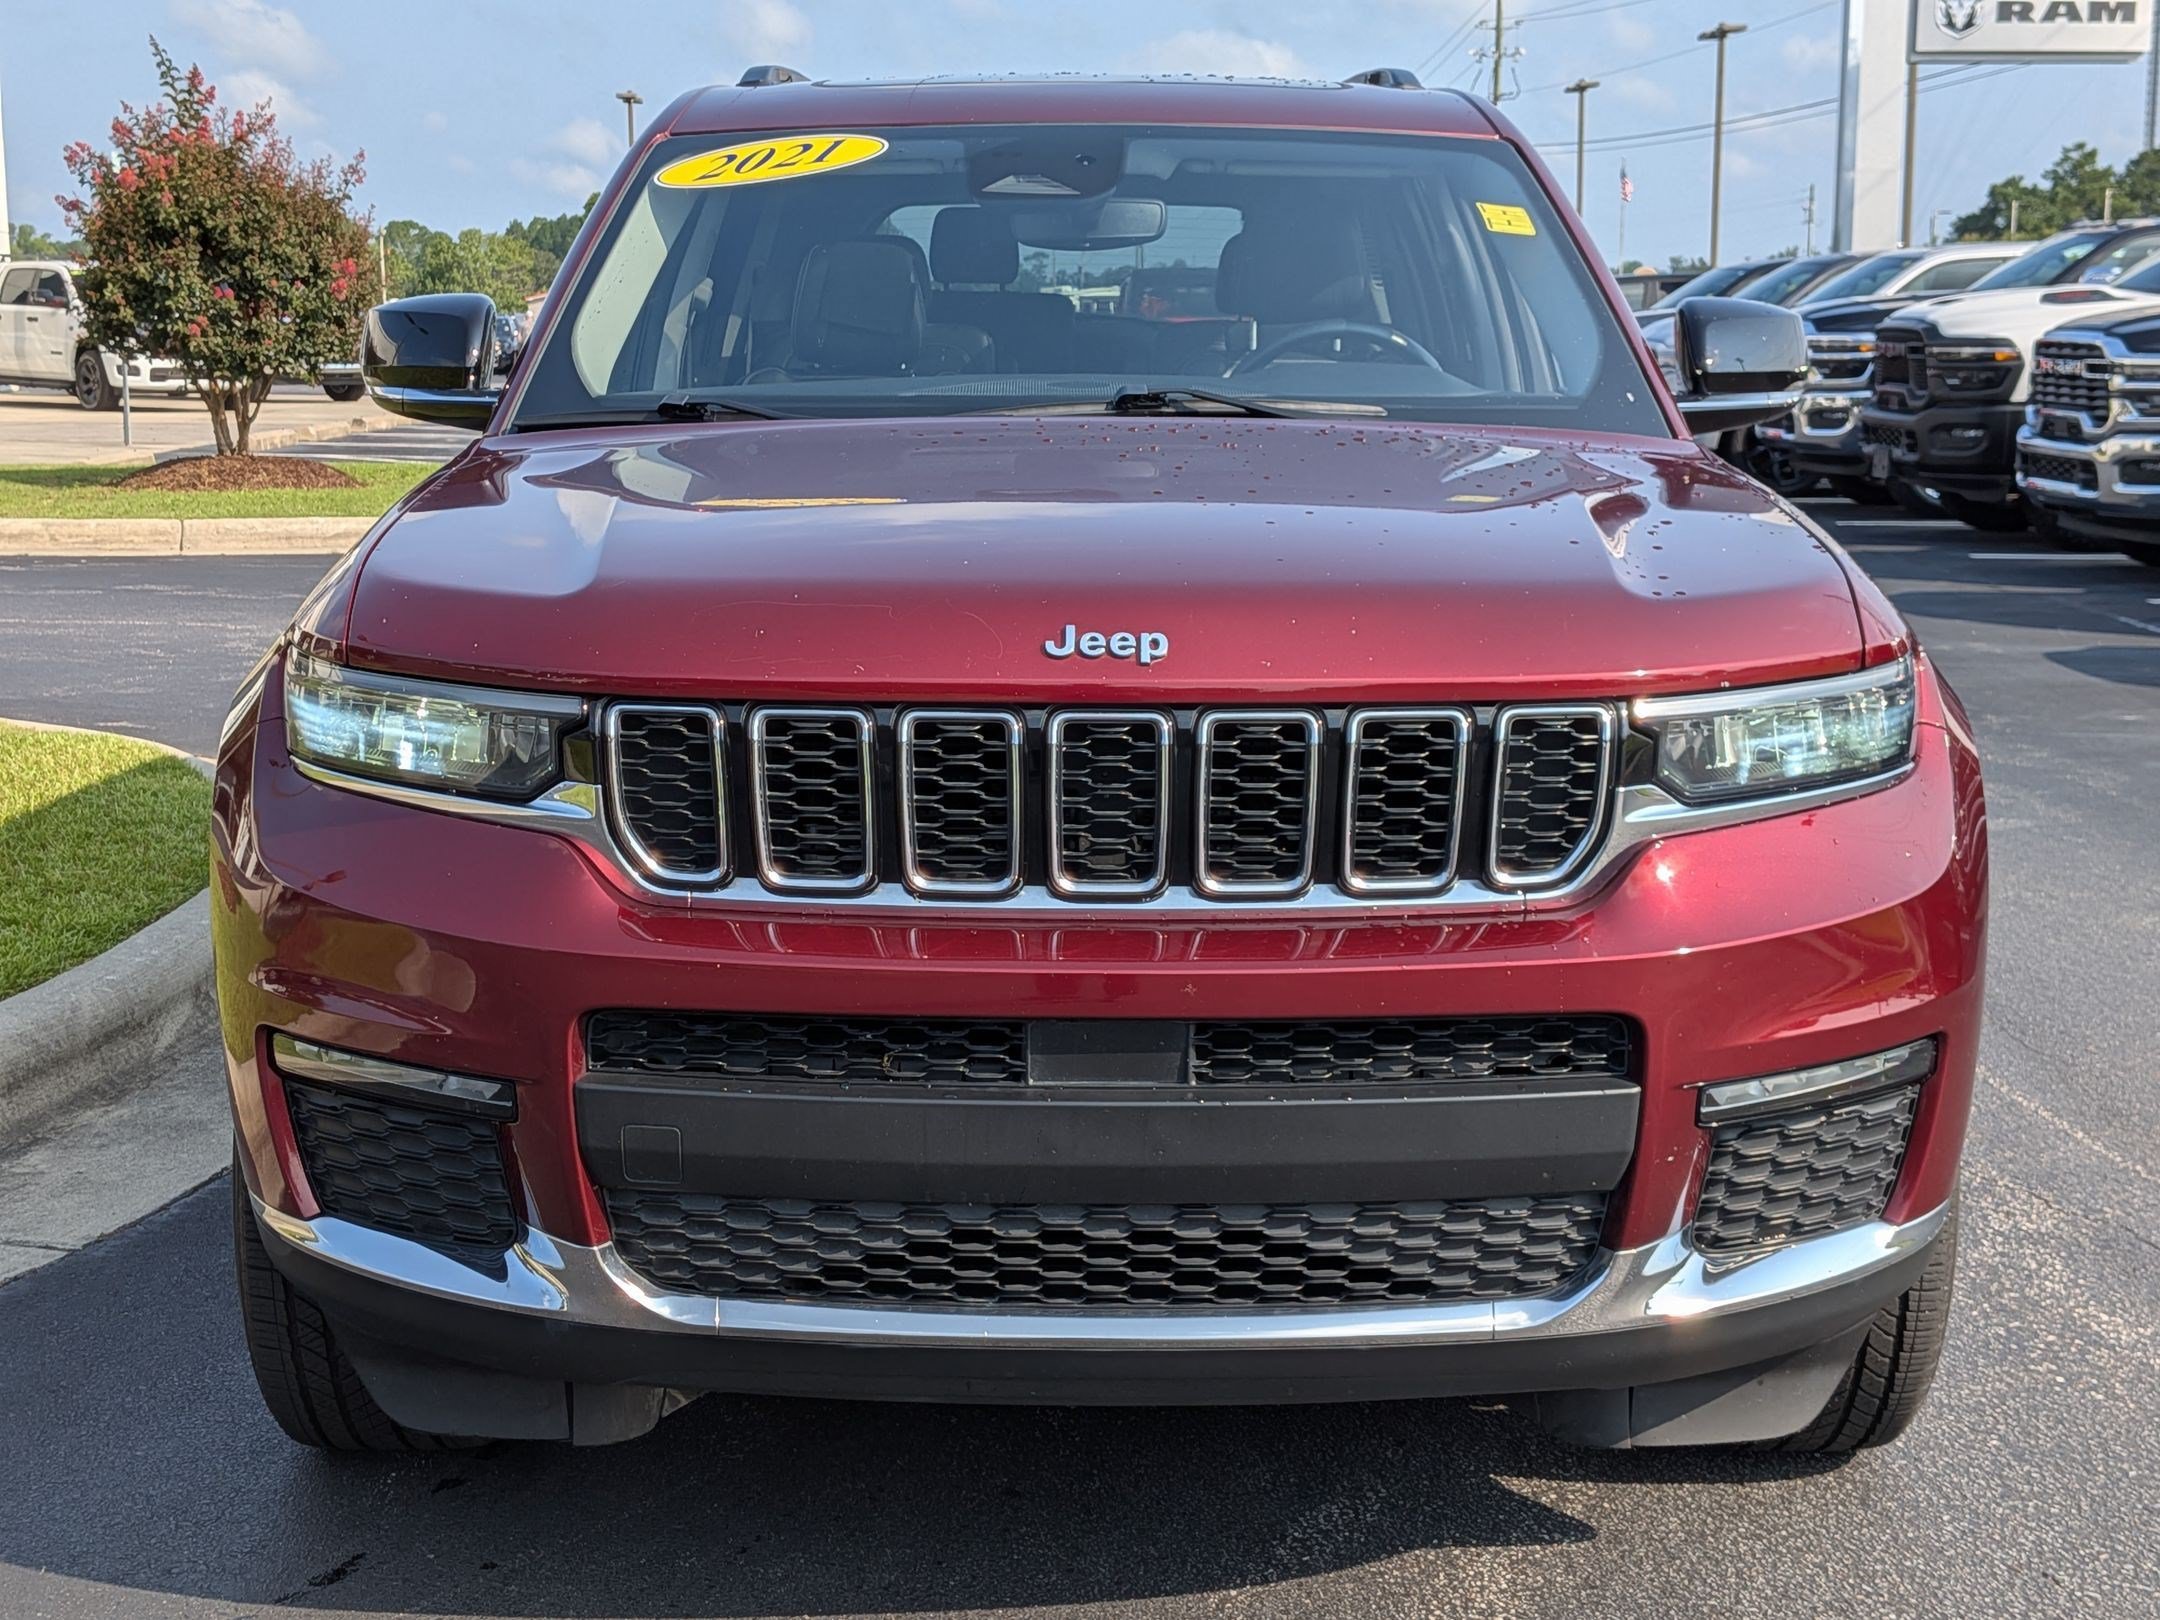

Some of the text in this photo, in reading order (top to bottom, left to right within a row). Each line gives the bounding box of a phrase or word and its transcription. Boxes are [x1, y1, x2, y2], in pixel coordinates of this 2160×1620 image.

[1996, 1, 2136, 23] RAM
[693, 139, 847, 181] 2021
[1043, 624, 1169, 665] Jeep
